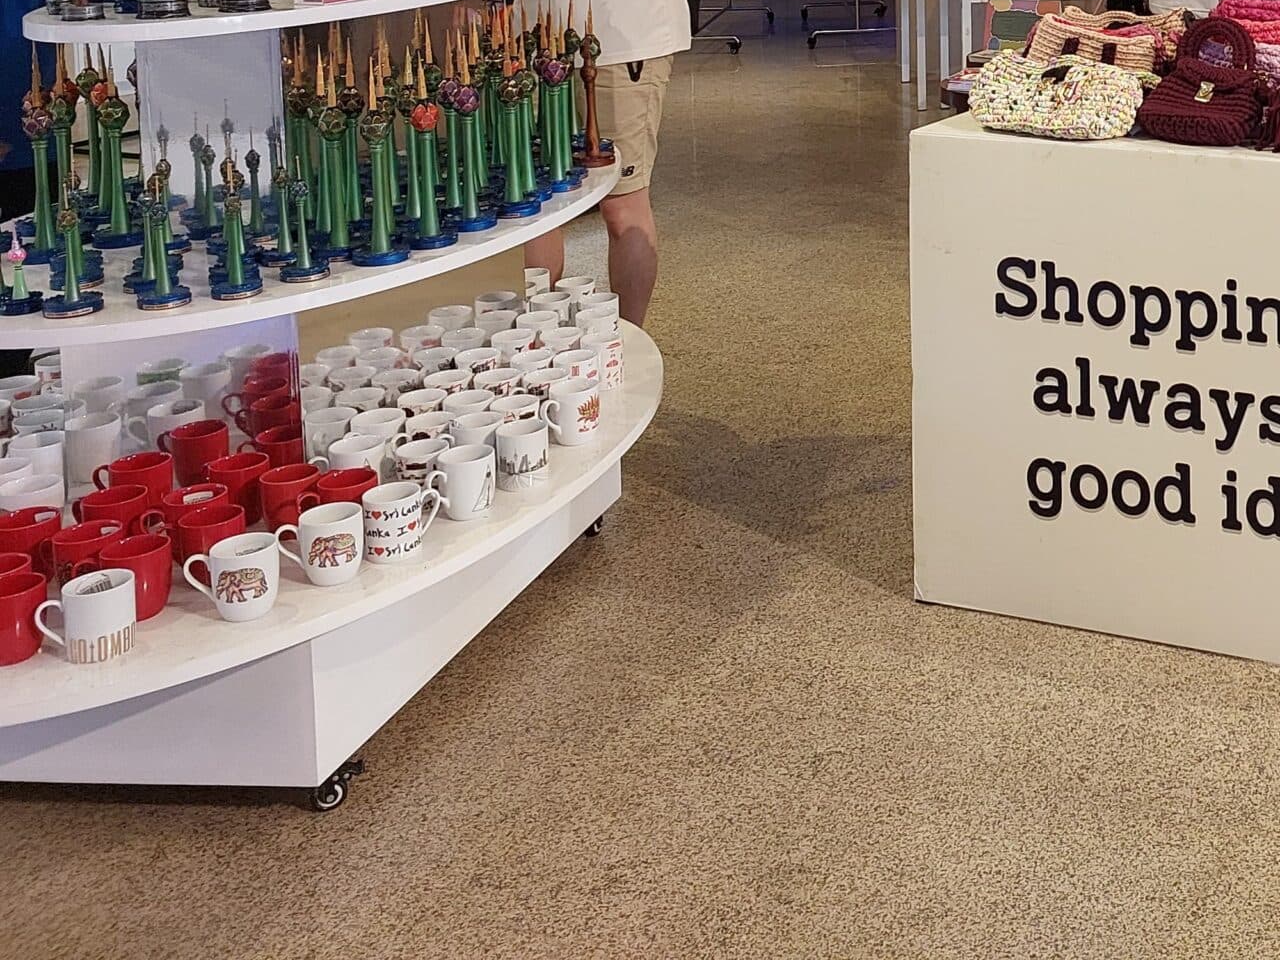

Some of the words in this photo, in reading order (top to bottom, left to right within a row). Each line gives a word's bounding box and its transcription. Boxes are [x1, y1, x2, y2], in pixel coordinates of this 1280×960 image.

[1026, 457, 1197, 524] good
[382, 508, 400, 521] Sri
[402, 499, 421, 517] Lank
[366, 528, 391, 538] anka
[385, 544, 402, 557] Sri
[404, 534, 422, 552] Lank
